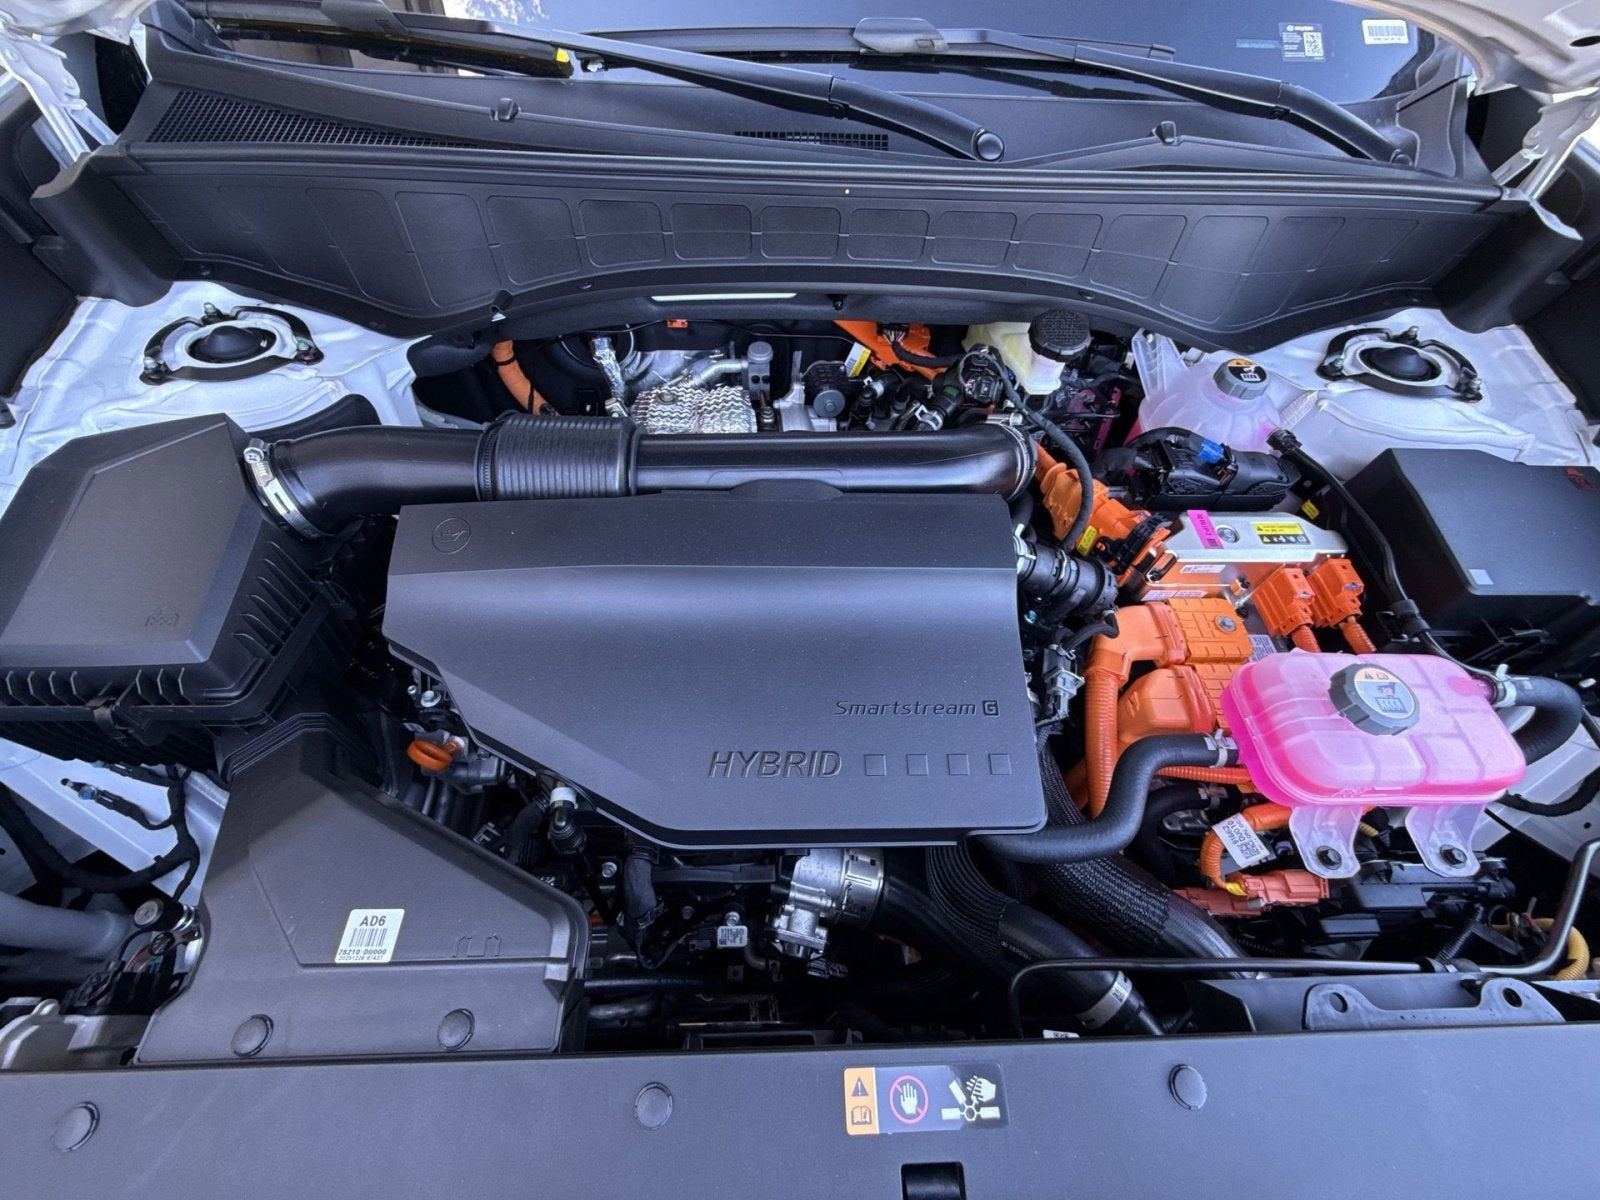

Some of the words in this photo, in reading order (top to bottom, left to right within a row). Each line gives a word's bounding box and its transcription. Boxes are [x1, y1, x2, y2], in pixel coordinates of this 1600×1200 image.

[834, 700, 976, 716] Smartstream
[982, 699, 999, 716] G
[708, 750, 843, 778] HYBRID
[359, 915, 387, 927] AD6
